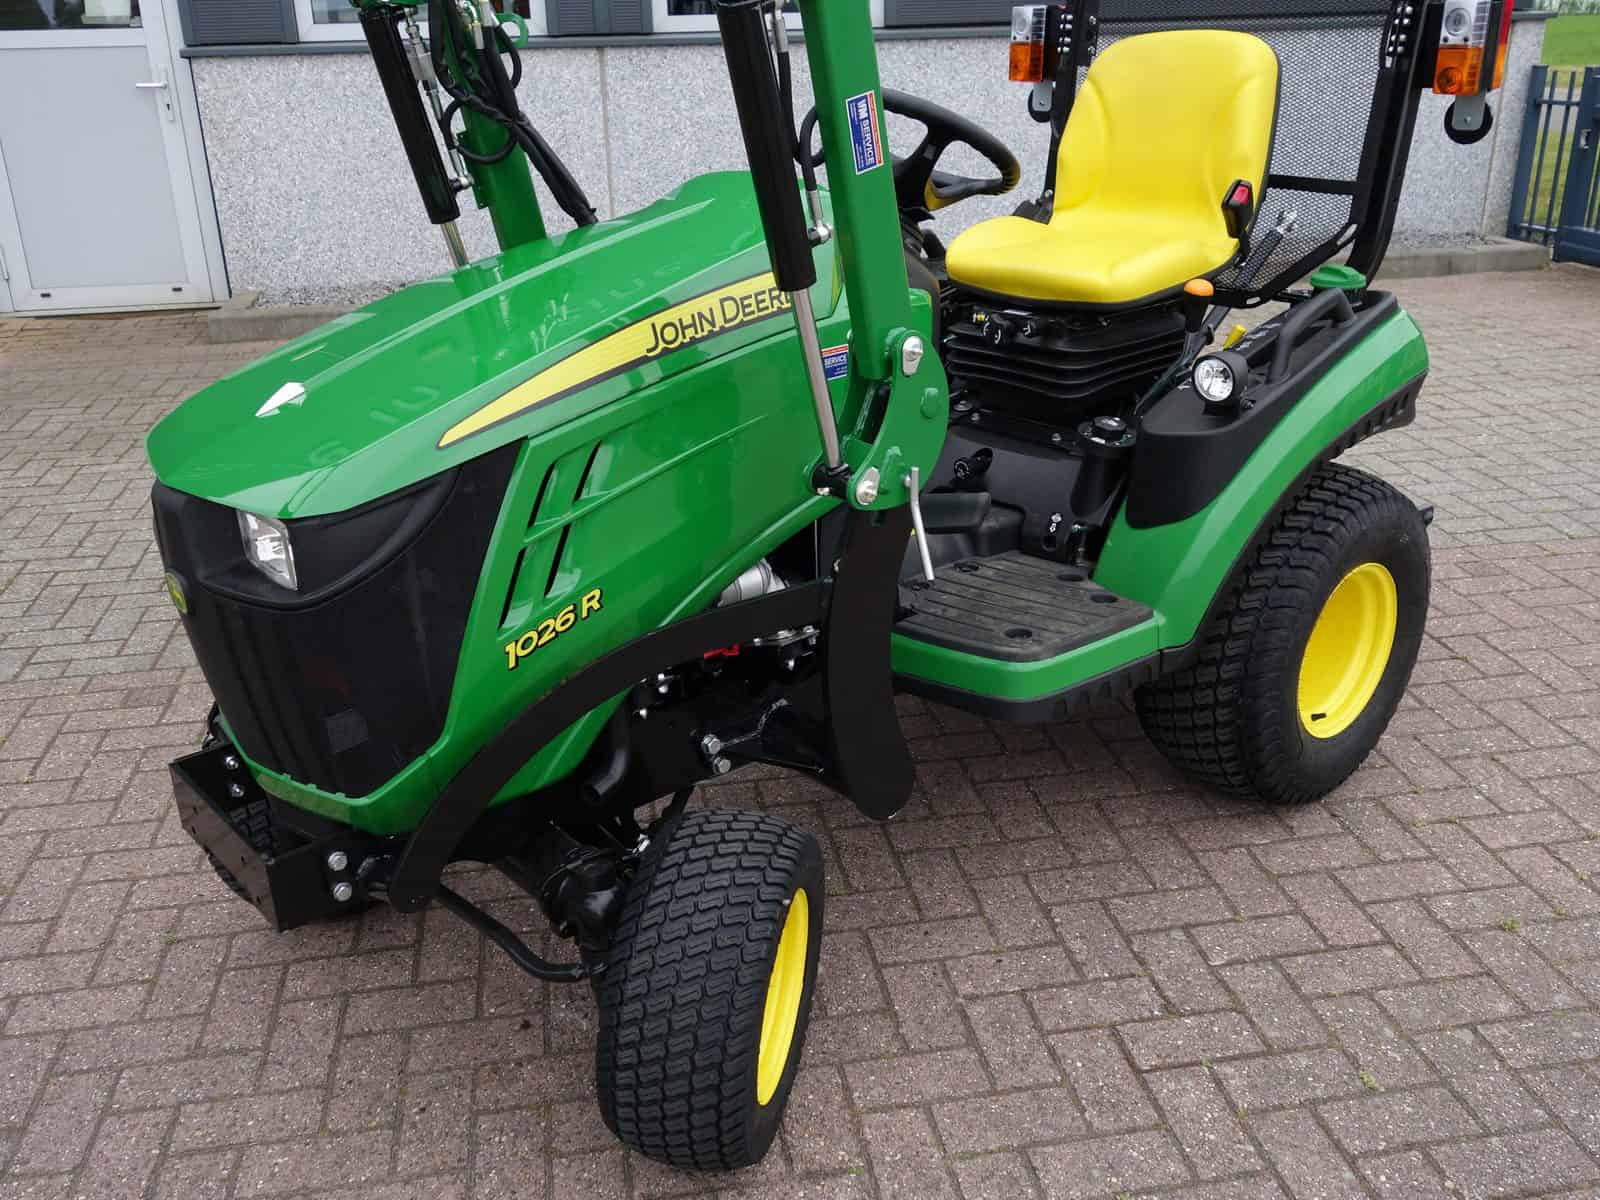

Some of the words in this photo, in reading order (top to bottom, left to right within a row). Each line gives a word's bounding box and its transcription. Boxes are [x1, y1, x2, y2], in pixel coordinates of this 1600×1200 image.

[862, 119, 875, 165] SERVICE
[646, 308, 716, 354] JOHN
[504, 604, 576, 671] 1026
[581, 587, 604, 620] R
